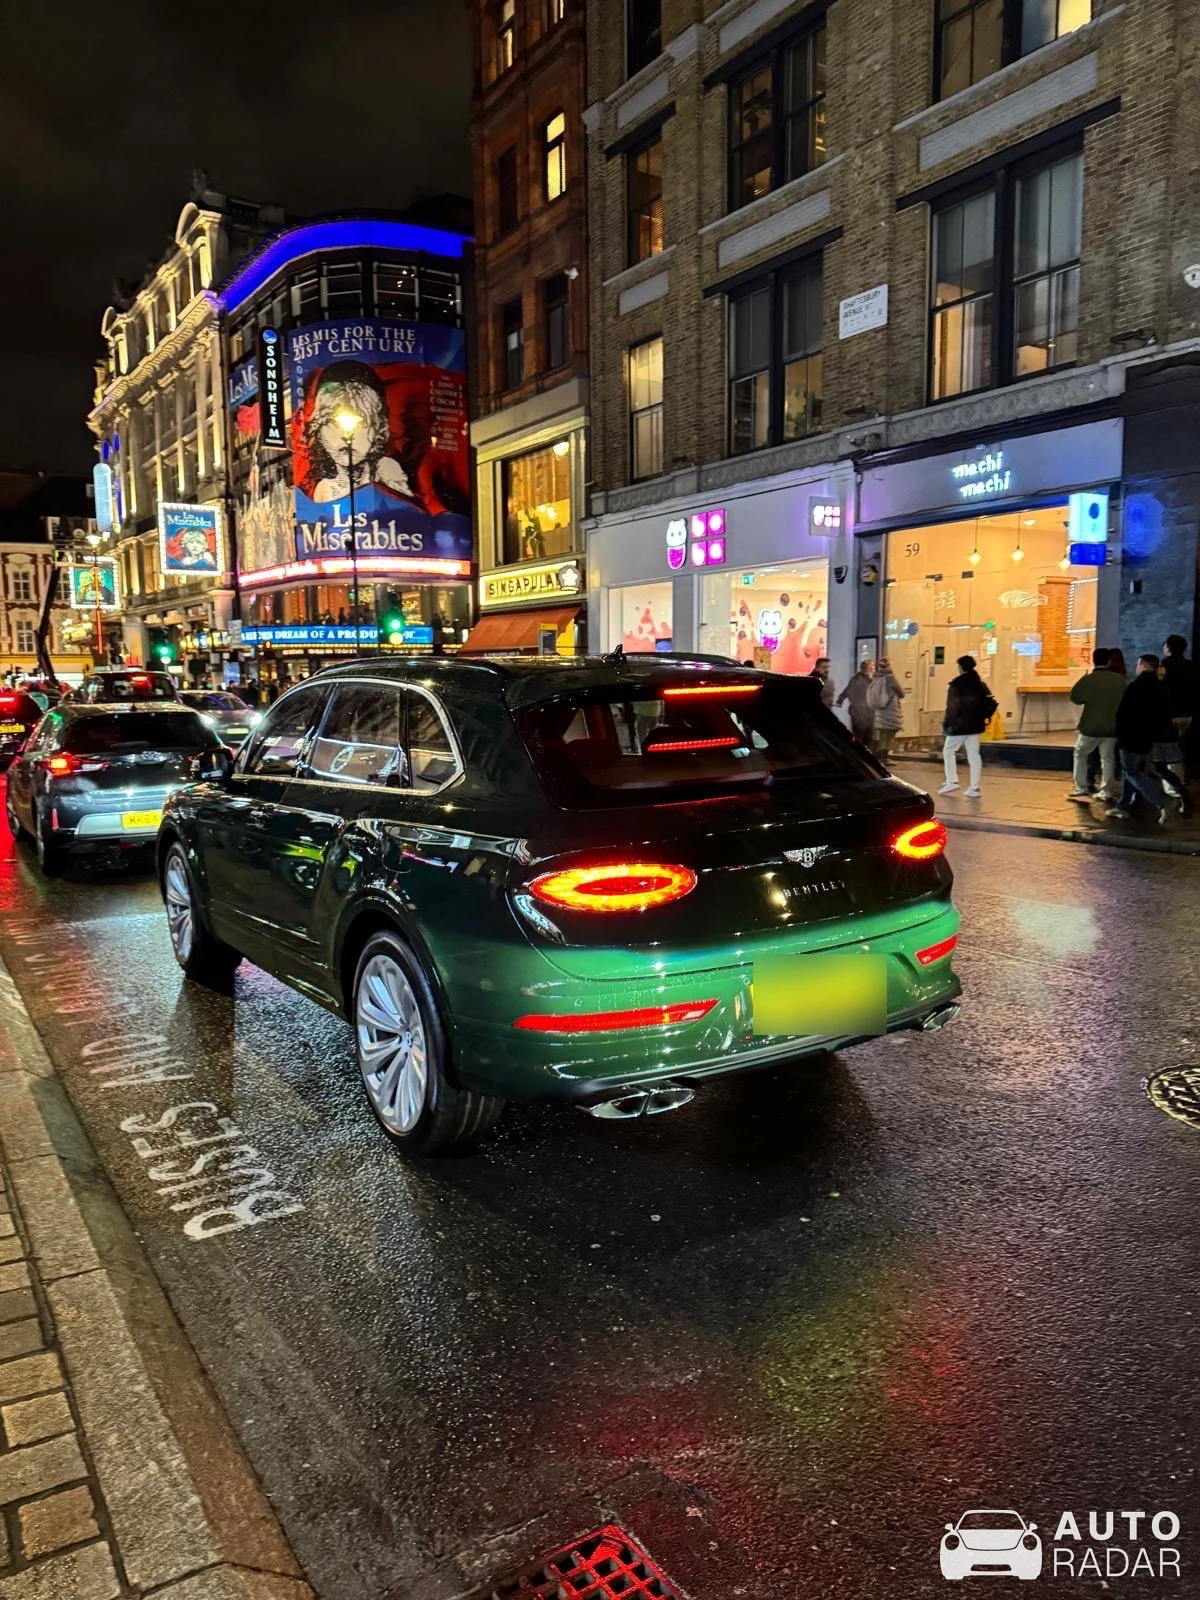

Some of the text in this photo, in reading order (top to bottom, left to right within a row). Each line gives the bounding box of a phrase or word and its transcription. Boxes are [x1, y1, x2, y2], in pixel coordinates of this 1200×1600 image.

[292, 325, 416, 348] LES MIS FOR THE
[293, 338, 416, 361] 21ST CENTURY
[265, 345, 280, 438] SONDHEIM
[952, 452, 1003, 478] machi
[960, 470, 1011, 497] machi
[332, 504, 368, 528] Les
[300, 519, 423, 554] Misérables
[904, 542, 920, 558] 59
[275, 629, 308, 640] DREAM
[310, 629, 325, 639] OF
[327, 629, 335, 639] A
[783, 880, 846, 897] BENTLEY
